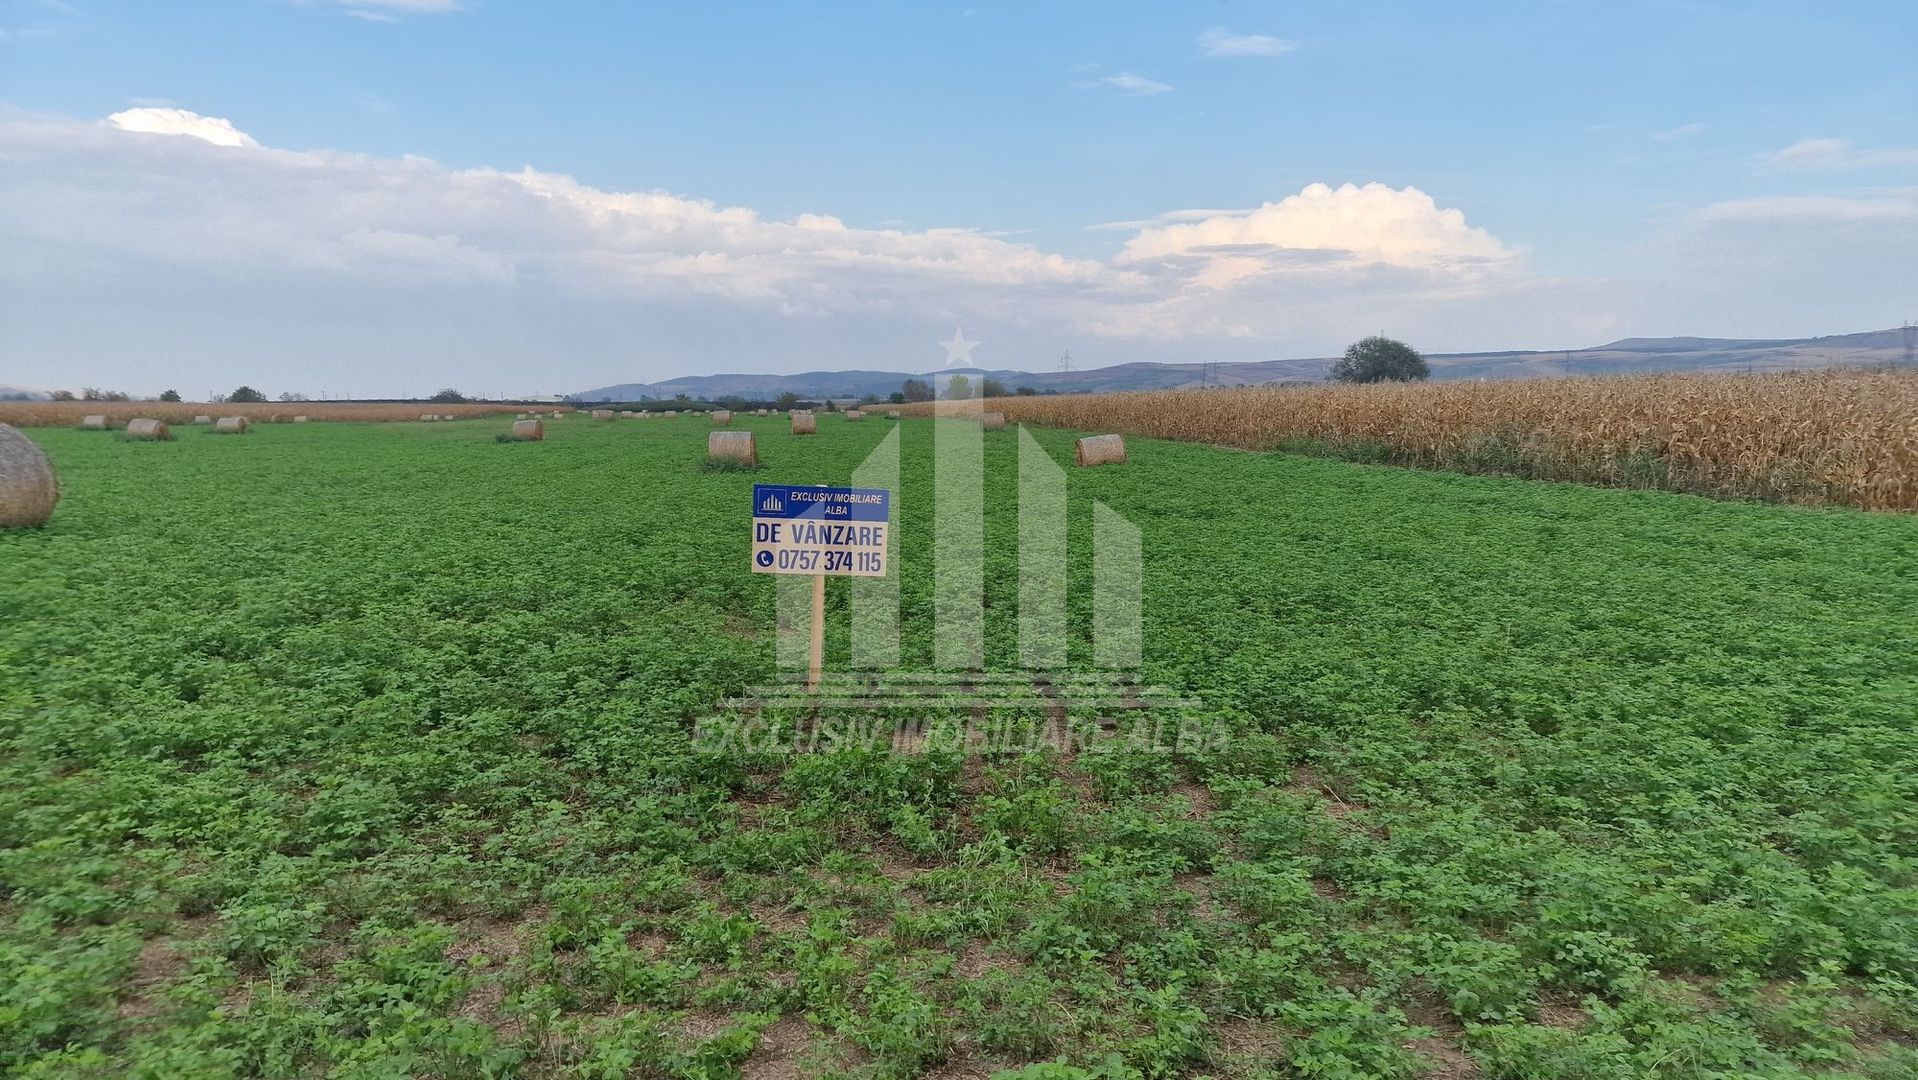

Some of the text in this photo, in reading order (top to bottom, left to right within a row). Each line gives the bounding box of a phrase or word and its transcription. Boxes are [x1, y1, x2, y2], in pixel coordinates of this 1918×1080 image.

[791, 491, 882, 504] EXCLUSIV IMOBILIARE
[824, 505, 848, 515] ALBA
[756, 520, 883, 546] DE VÂNZARE
[778, 549, 881, 572] 0757 374 115
